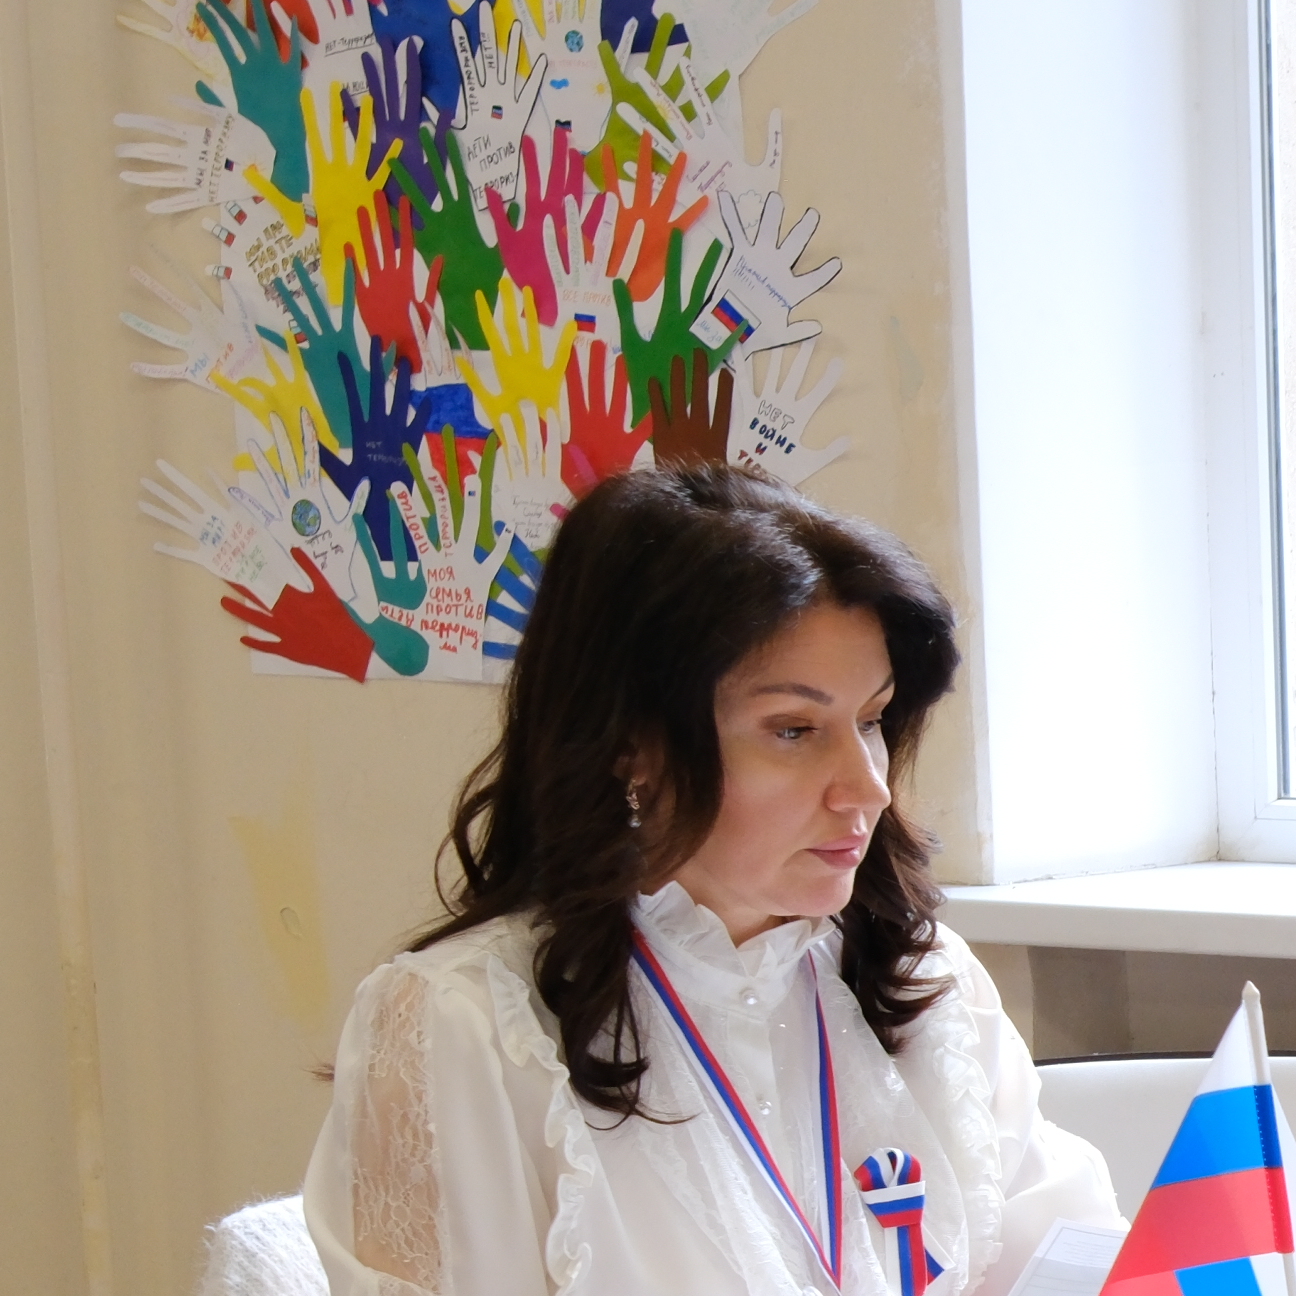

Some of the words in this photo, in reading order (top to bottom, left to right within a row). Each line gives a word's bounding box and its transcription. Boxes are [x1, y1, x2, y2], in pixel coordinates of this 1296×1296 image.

[479, 141, 516, 172] ПРОТИВ
[757, 400, 796, 430] НЕТ
[748, 417, 797, 455] ВОЙНЕ
[755, 440, 768, 457] И
[398, 489, 429, 556] ПРОТИВ
[427, 565, 456, 583] МОЯ
[425, 602, 484, 620] ПРОТИВ
